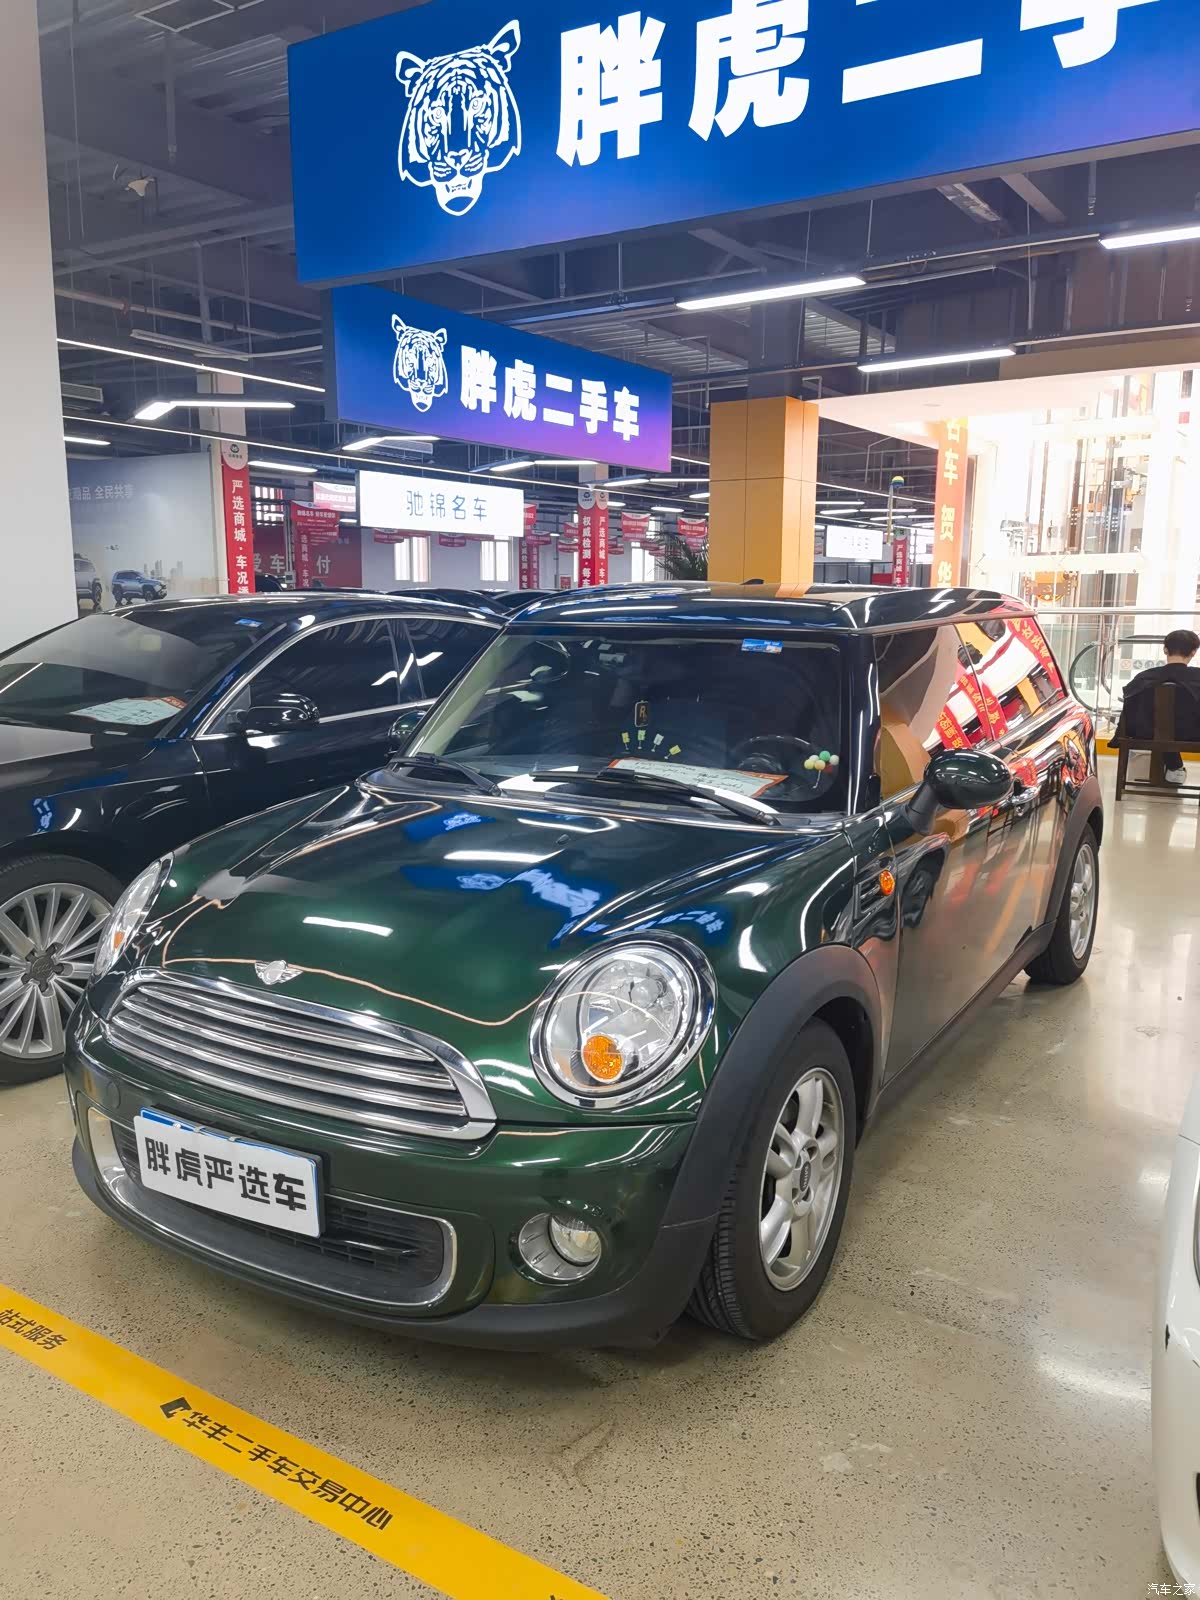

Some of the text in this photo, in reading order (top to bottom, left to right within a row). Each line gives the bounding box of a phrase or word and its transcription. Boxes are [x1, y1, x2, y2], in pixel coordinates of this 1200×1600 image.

[460, 345, 640, 441] 胖虎二手车
[406, 490, 487, 522] 驰锦名车
[144, 1137, 307, 1211] 胖虎严选车
[182, 1411, 393, 1531] 华丰二手车交易中心
